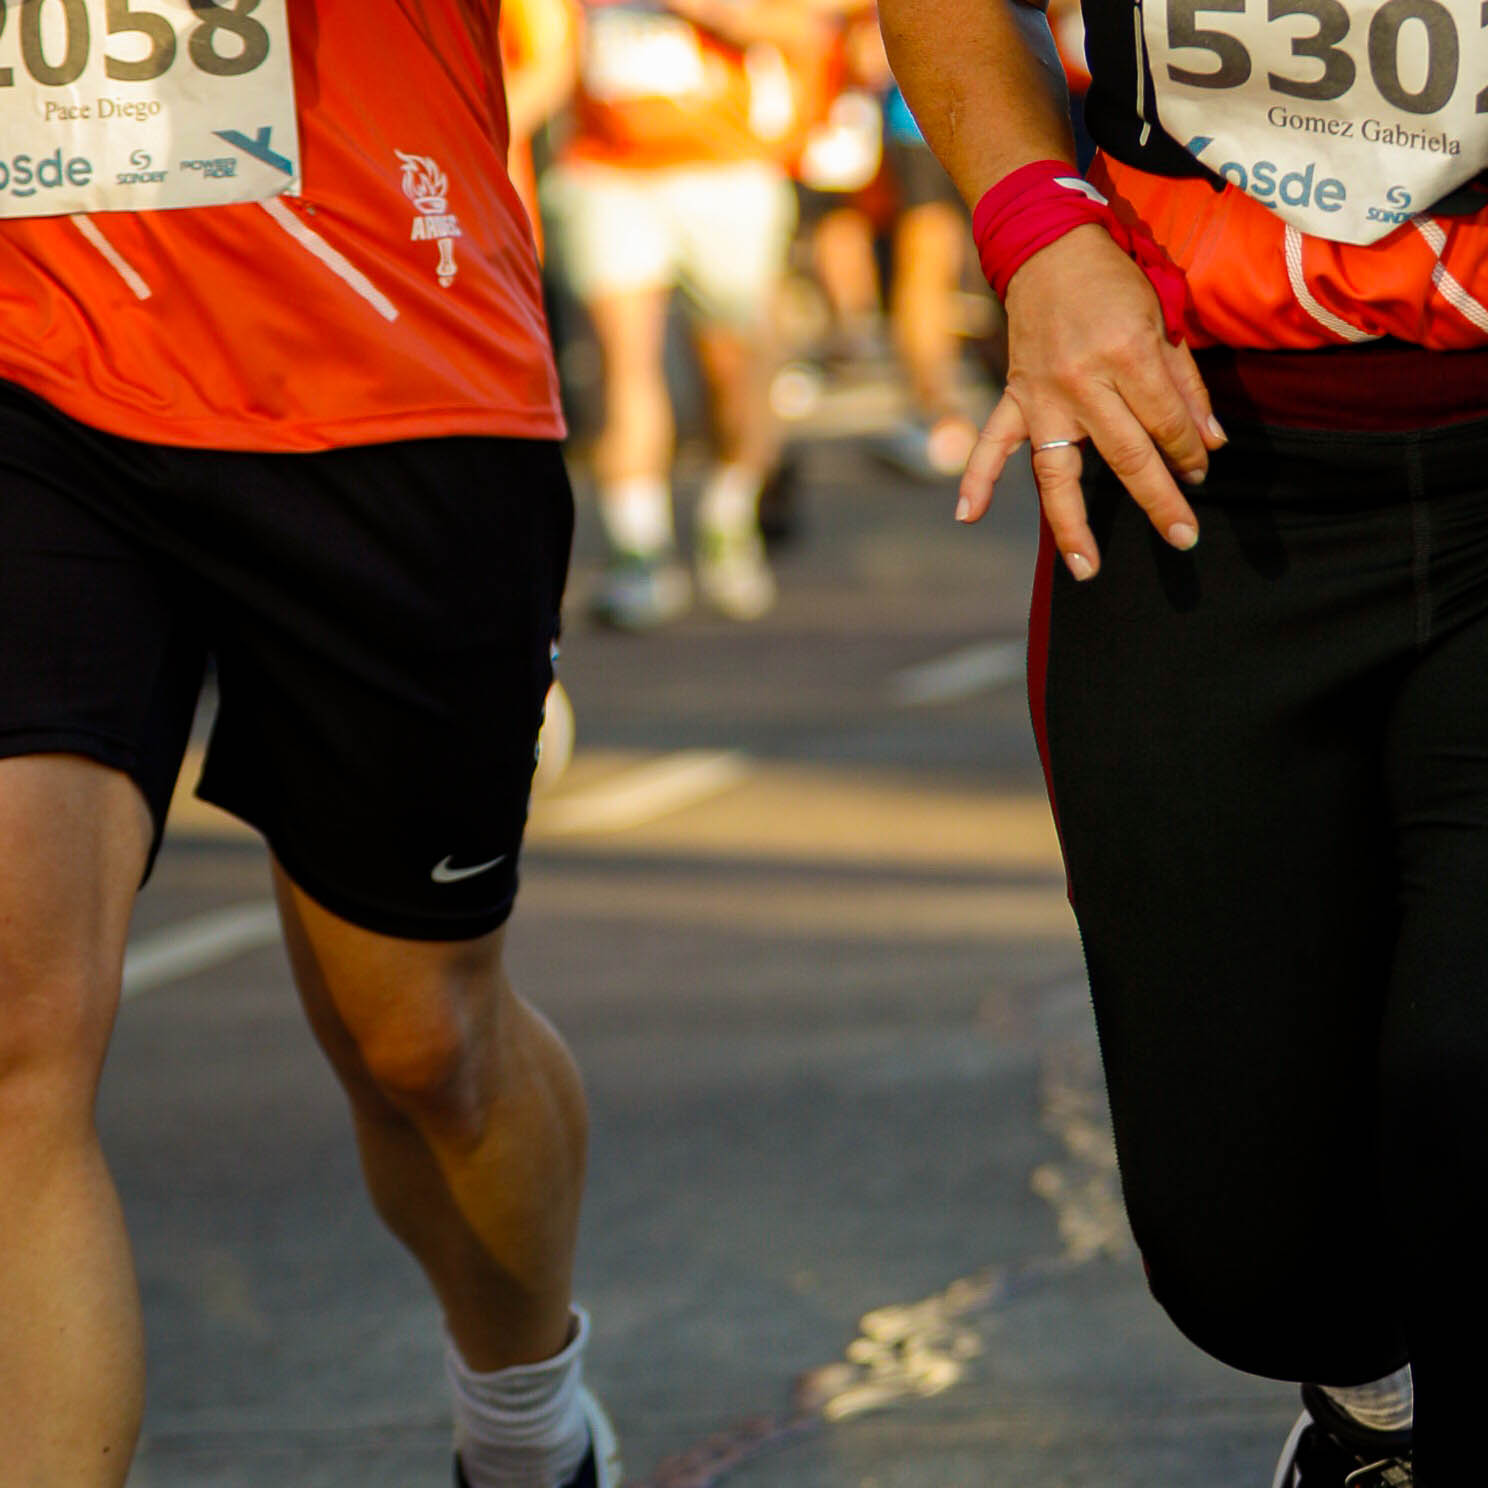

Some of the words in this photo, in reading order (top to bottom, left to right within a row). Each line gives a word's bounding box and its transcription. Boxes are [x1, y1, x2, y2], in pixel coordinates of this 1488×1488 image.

[44, 100, 91, 122] Pace
[97, 97, 161, 121] Diego
[1267, 105, 1354, 139] Gomez
[1361, 118, 1461, 156] Gabriela
[1218, 160, 1347, 212] osde
